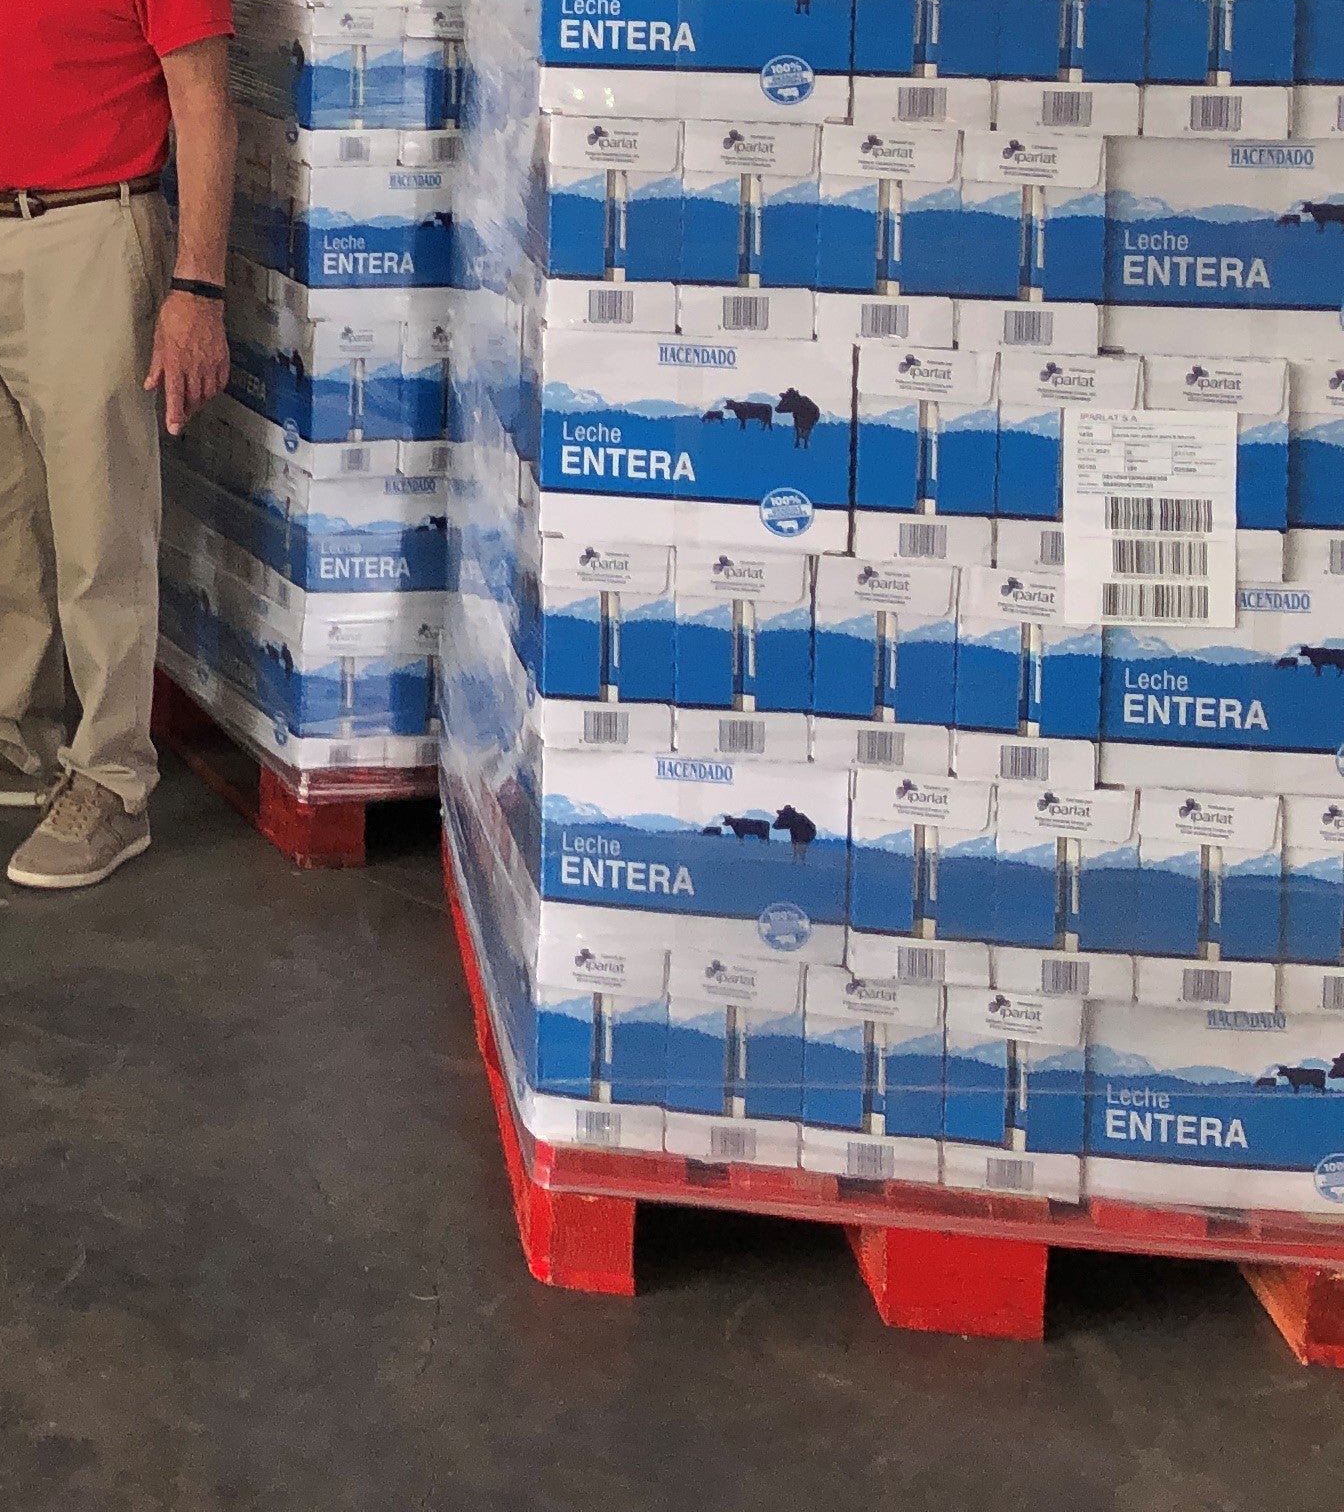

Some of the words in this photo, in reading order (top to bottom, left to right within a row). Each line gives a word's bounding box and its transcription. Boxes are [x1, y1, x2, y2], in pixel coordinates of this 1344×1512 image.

[560, 20, 696, 53] ENTERA
[599, 135, 638, 150] iparlat
[735, 139, 776, 156] iparlat
[873, 144, 914, 161] iparlat
[1013, 148, 1057, 166] iparlat
[1229, 146, 1314, 168] HACENDADO
[324, 235, 365, 250] Leche
[1124, 229, 1189, 251] Leche
[324, 252, 414, 274] ENTERA
[1123, 256, 1270, 290] ENTERA
[658, 346, 736, 368] HACENDADO
[909, 364, 952, 381] iparlat
[1052, 372, 1096, 389] iparlat
[1198, 375, 1242, 392] iparlat
[562, 422, 621, 443] Leche
[561, 449, 695, 483] ENTERA
[770, 493, 803, 506] 100%
[321, 558, 410, 579] ENTERA
[584, 558, 629, 573] iparlat
[721, 564, 765, 581] iparlat
[867, 576, 911, 593] iparlat
[1014, 588, 1056, 605] iparlat
[1240, 592, 1310, 610] ACENDADO
[1124, 668, 1188, 690] Leche
[1124, 695, 1269, 731] ENTERA
[656, 759, 734, 782] HACENDADO
[906, 788, 949, 805] iparlat
[1048, 802, 1091, 819] iparlat
[1189, 807, 1233, 824] iparlat
[561, 832, 621, 855] Leche
[561, 860, 694, 896] ENTERA
[1107, 1084, 1170, 1110] Leche
[1107, 1111, 1247, 1148] ENTERA
